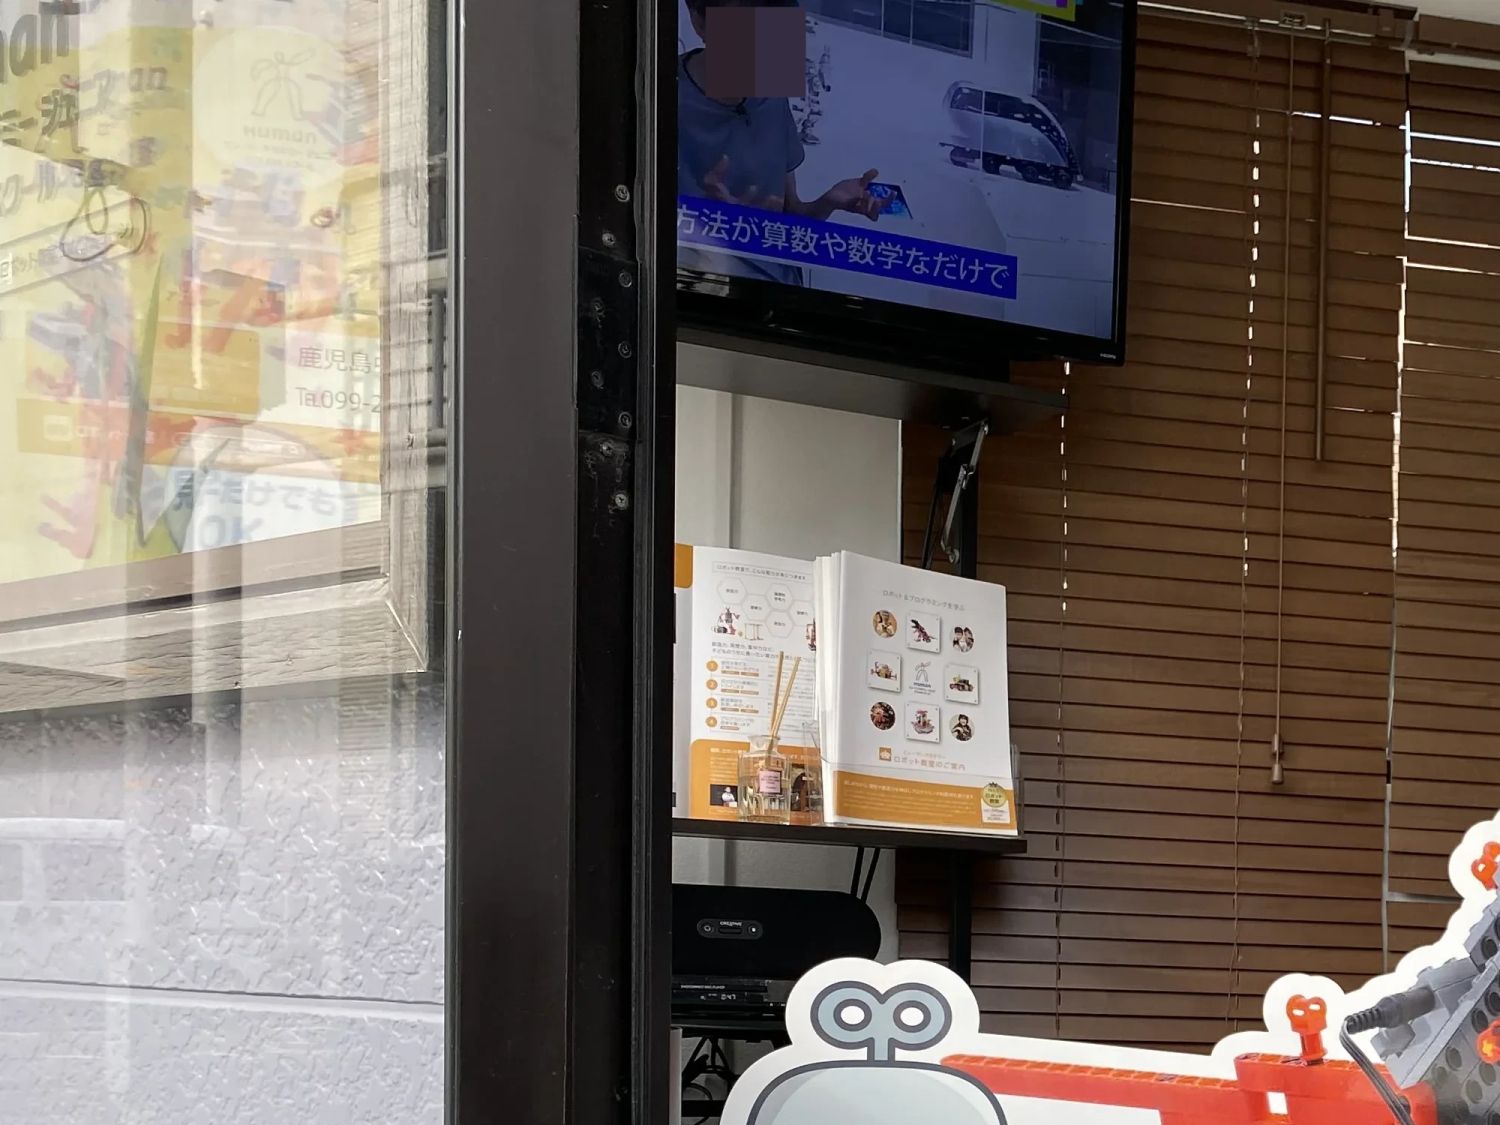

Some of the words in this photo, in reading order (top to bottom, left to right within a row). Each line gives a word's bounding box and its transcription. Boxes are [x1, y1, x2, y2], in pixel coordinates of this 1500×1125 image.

[243, 125, 318, 145] Human
[677, 203, 1010, 289] 方法が算数や数学なだけで
